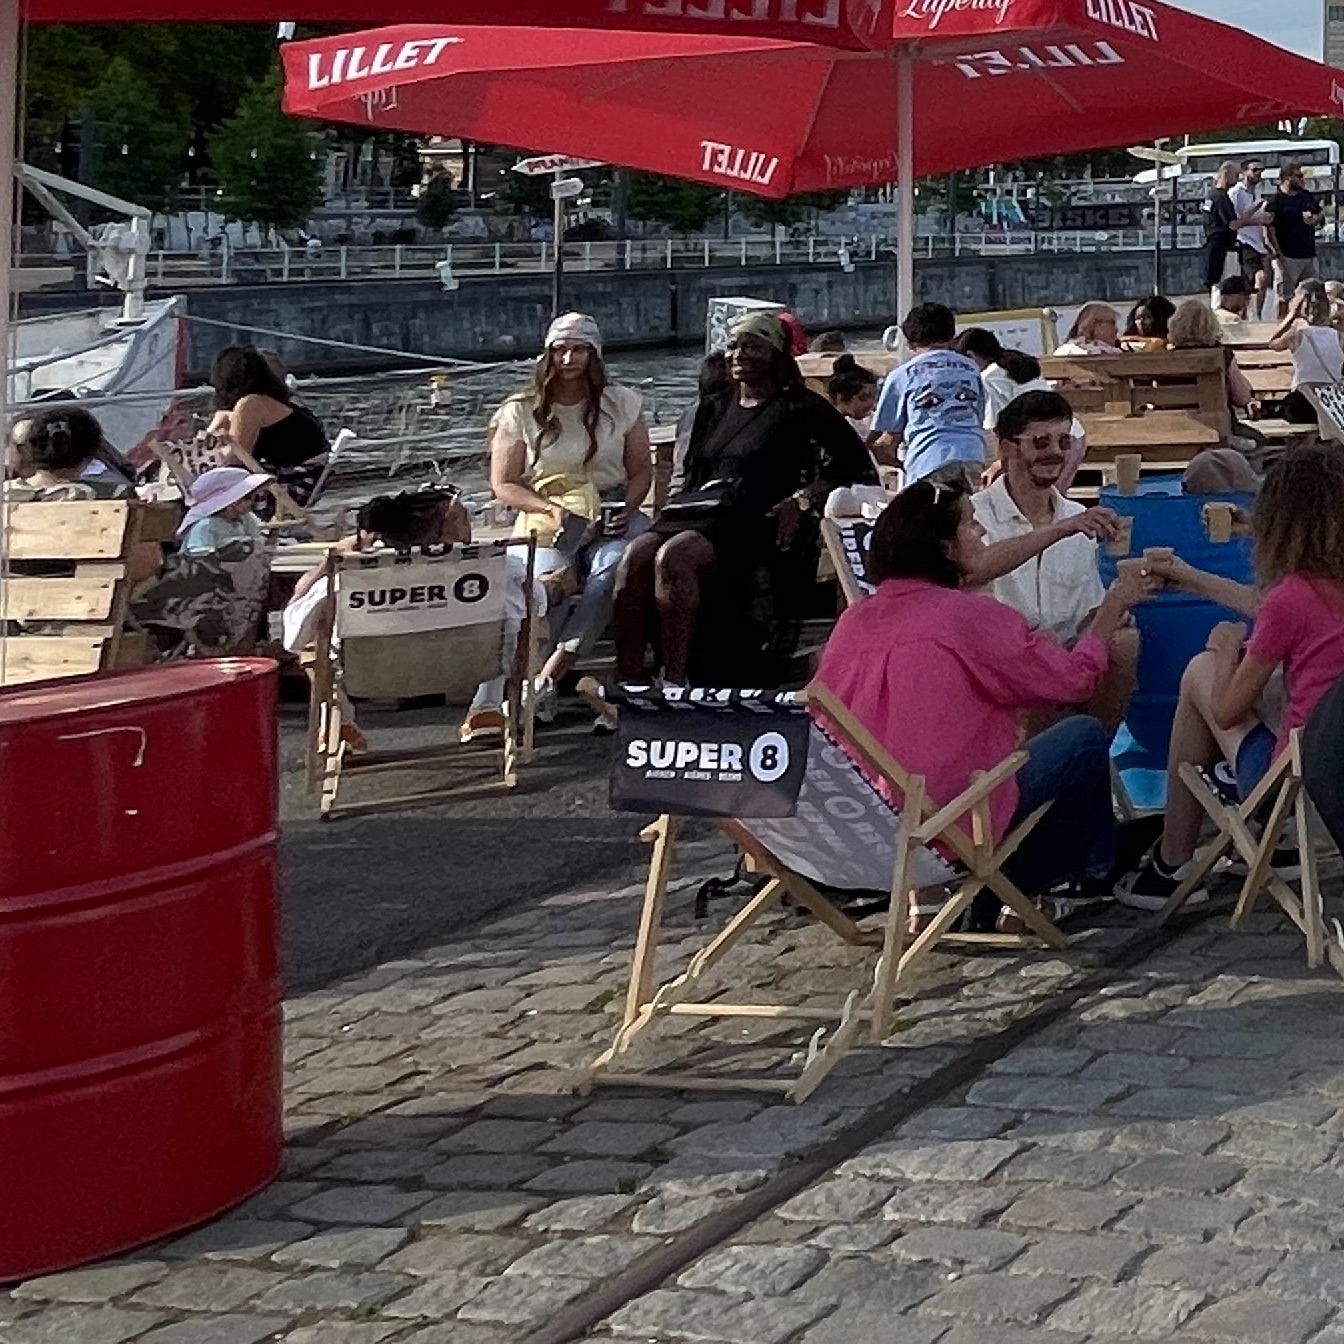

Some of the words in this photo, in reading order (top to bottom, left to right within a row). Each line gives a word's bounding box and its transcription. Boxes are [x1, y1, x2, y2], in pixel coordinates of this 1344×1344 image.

[308, 36, 464, 91] LILLET
[348, 584, 448, 610] SUPER
[626, 738, 744, 772] SUPER
